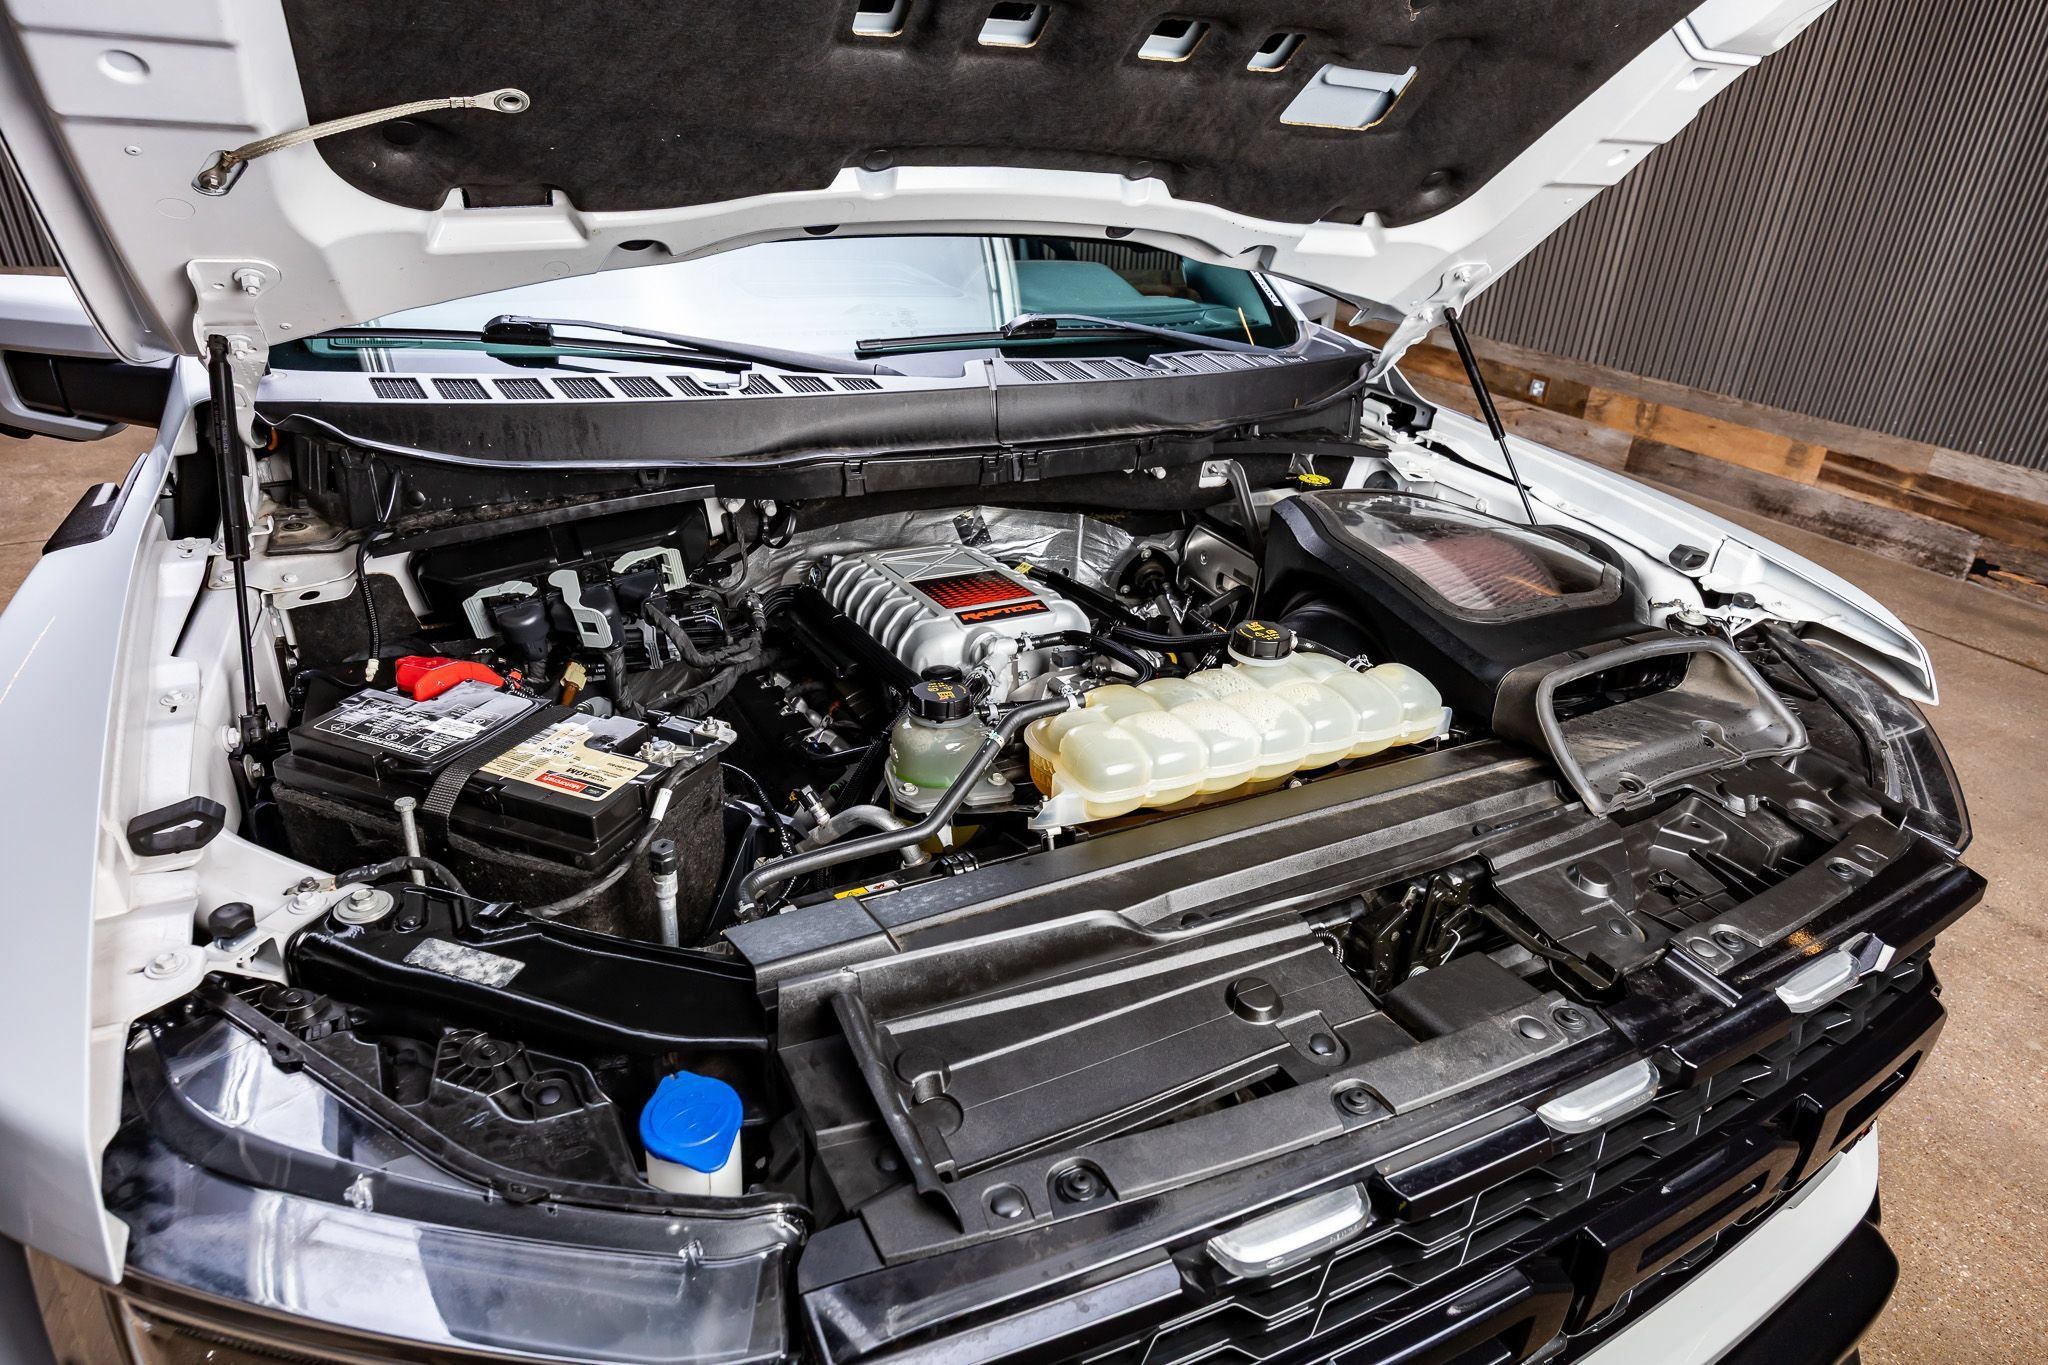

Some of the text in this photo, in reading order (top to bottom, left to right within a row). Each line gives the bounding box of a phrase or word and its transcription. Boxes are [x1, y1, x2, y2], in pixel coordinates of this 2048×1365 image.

[961, 602, 1048, 620] RAPTOR
[565, 768, 591, 778] AGM
[542, 775, 582, 790] Motorcraft
